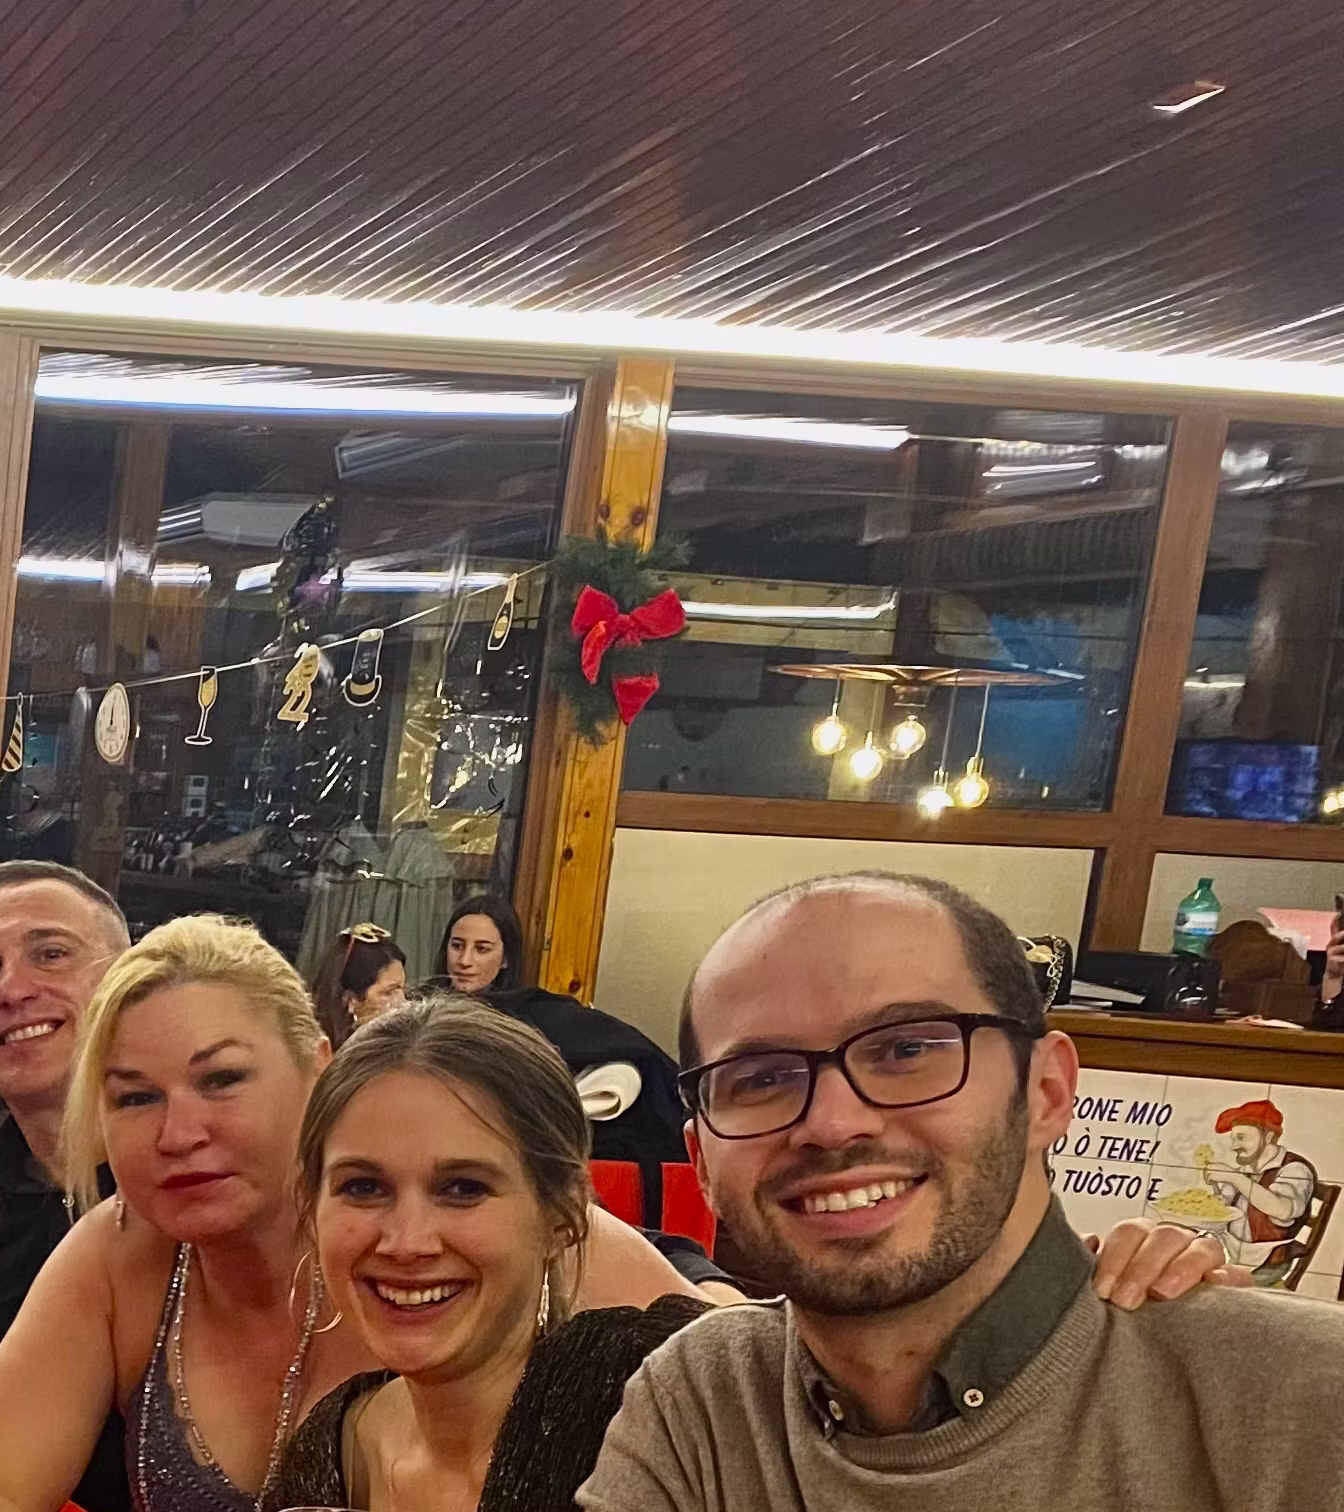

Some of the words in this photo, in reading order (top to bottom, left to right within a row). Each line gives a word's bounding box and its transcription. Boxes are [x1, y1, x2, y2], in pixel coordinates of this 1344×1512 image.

[1124, 1101, 1173, 1127] MIO
[1074, 1126, 1091, 1156] Ò
[1097, 1135, 1162, 1163] TENE!
[1062, 1165, 1143, 1200] TUÒSTO
[1147, 1177, 1164, 1201] E
